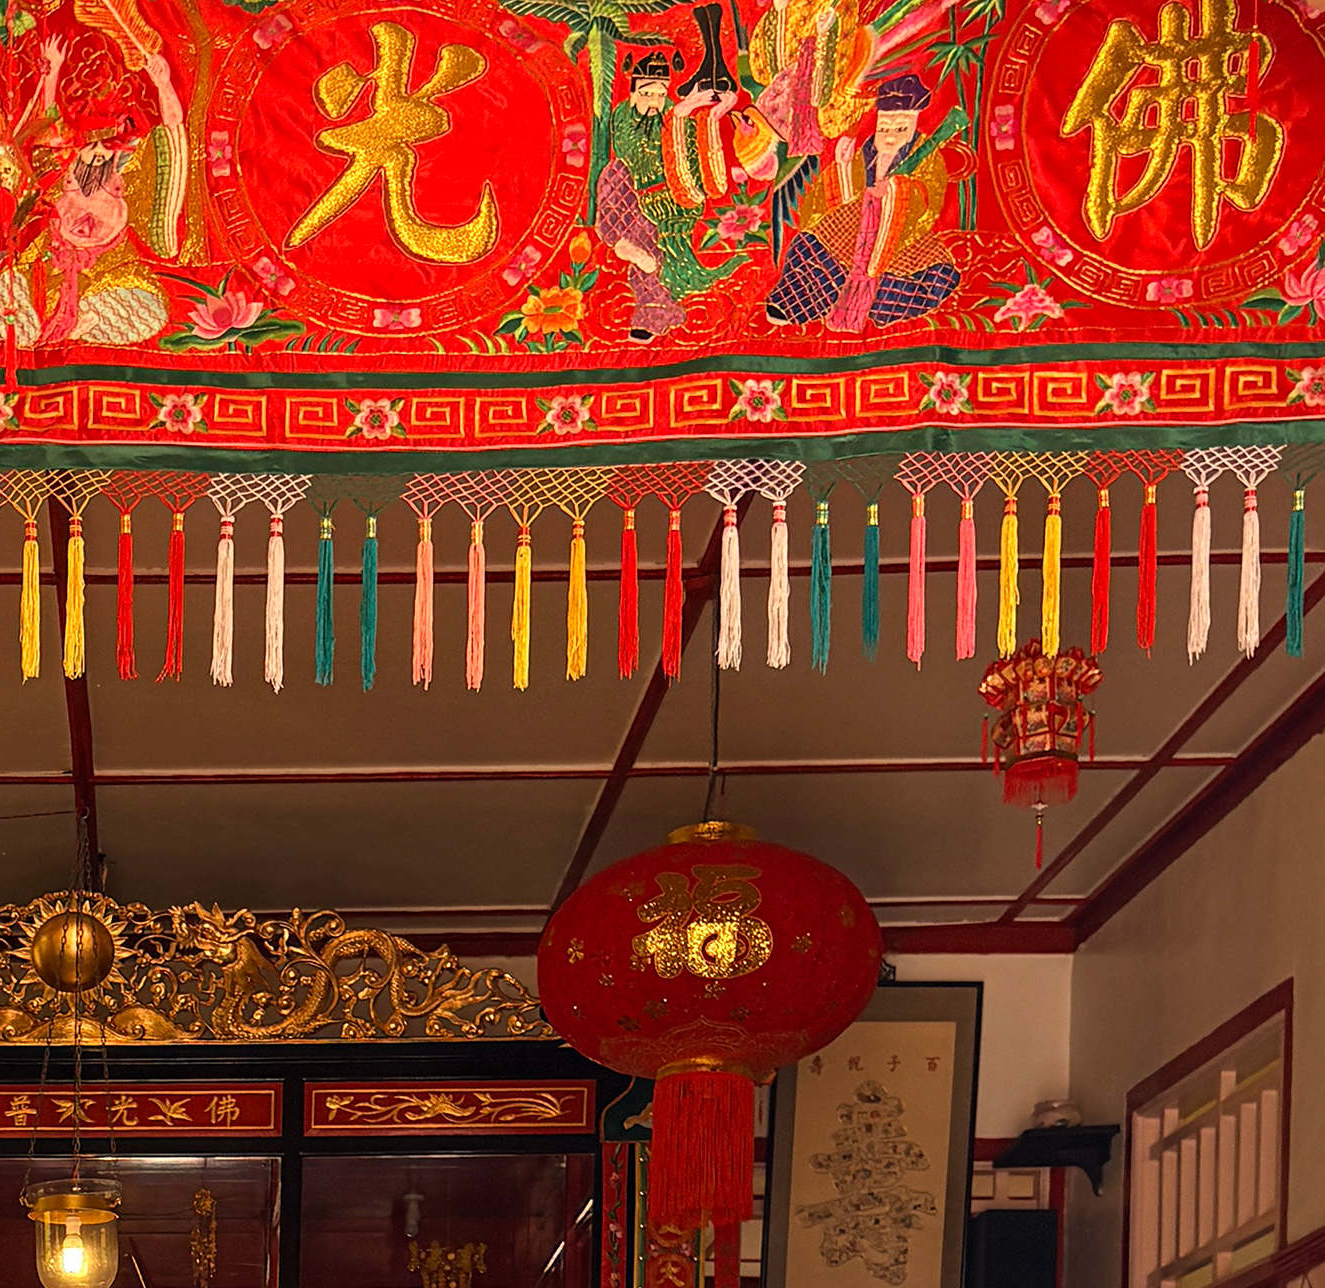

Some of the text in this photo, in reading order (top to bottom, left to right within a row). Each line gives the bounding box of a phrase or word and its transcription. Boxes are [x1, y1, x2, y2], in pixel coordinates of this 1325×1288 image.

[284, 20, 498, 266] 光
[1062, 0, 1286, 251] 佛
[631, 864, 774, 980] 福
